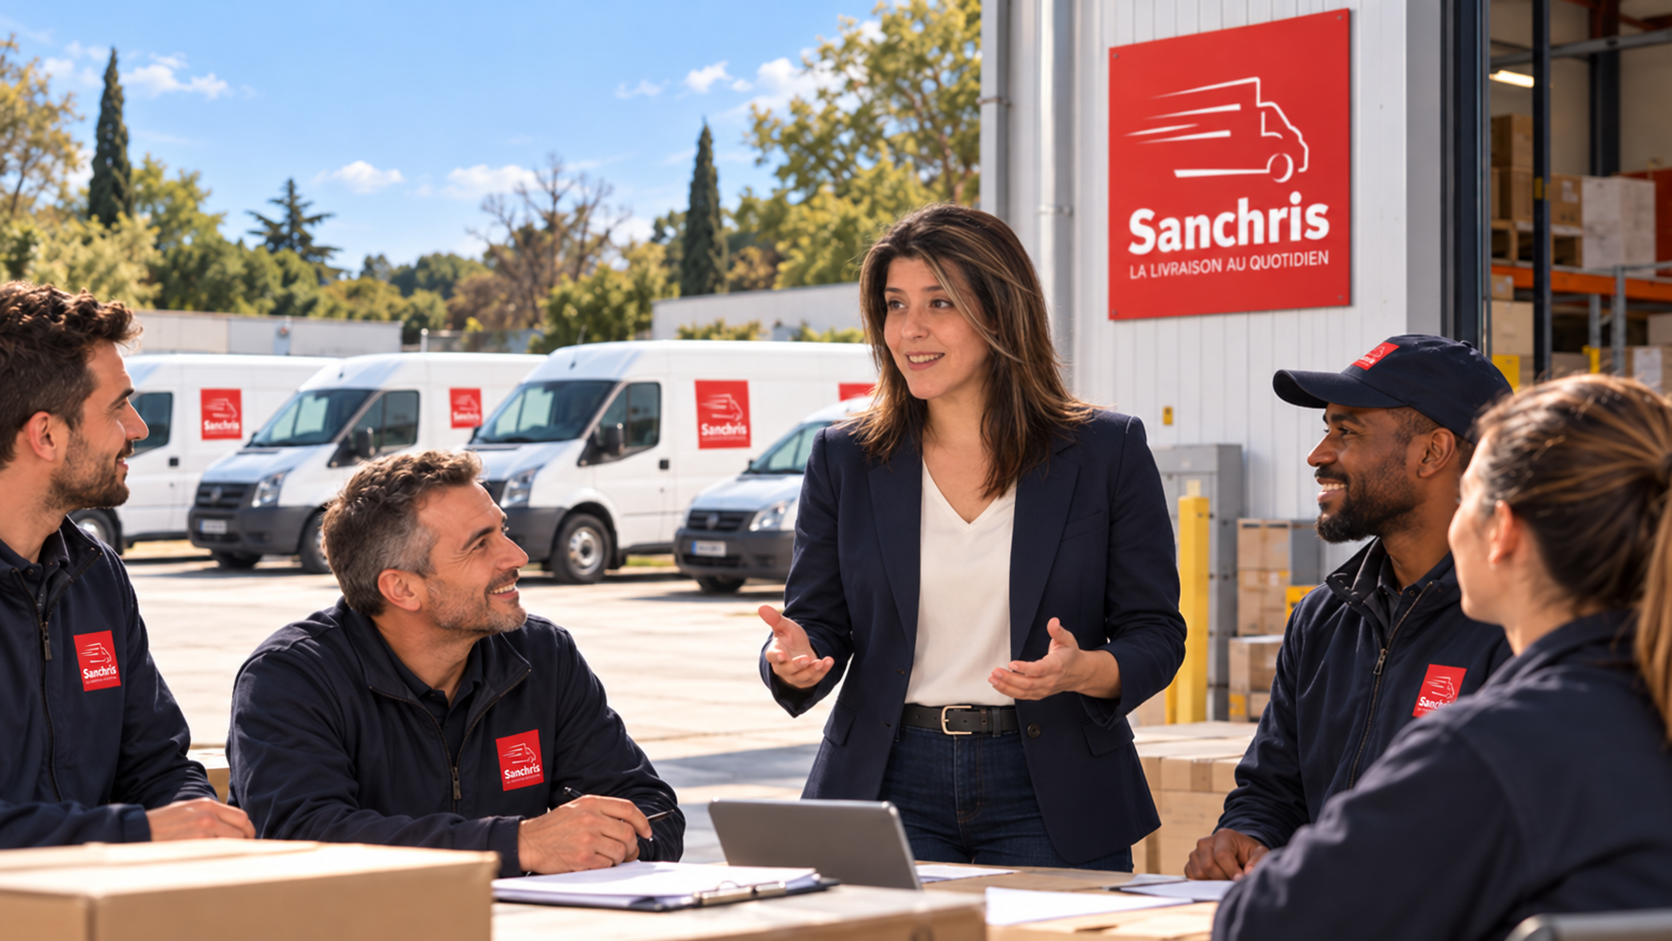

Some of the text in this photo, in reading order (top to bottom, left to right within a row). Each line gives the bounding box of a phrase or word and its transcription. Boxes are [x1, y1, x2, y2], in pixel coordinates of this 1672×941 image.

[1128, 191, 1330, 255] Sanchris
[1130, 250, 1329, 279] LA LIVRAISON AU QUOTIDIEN
[701, 421, 748, 436] Sanchris
[83, 664, 117, 679] Sanchris
[504, 763, 541, 779] Sanchris
